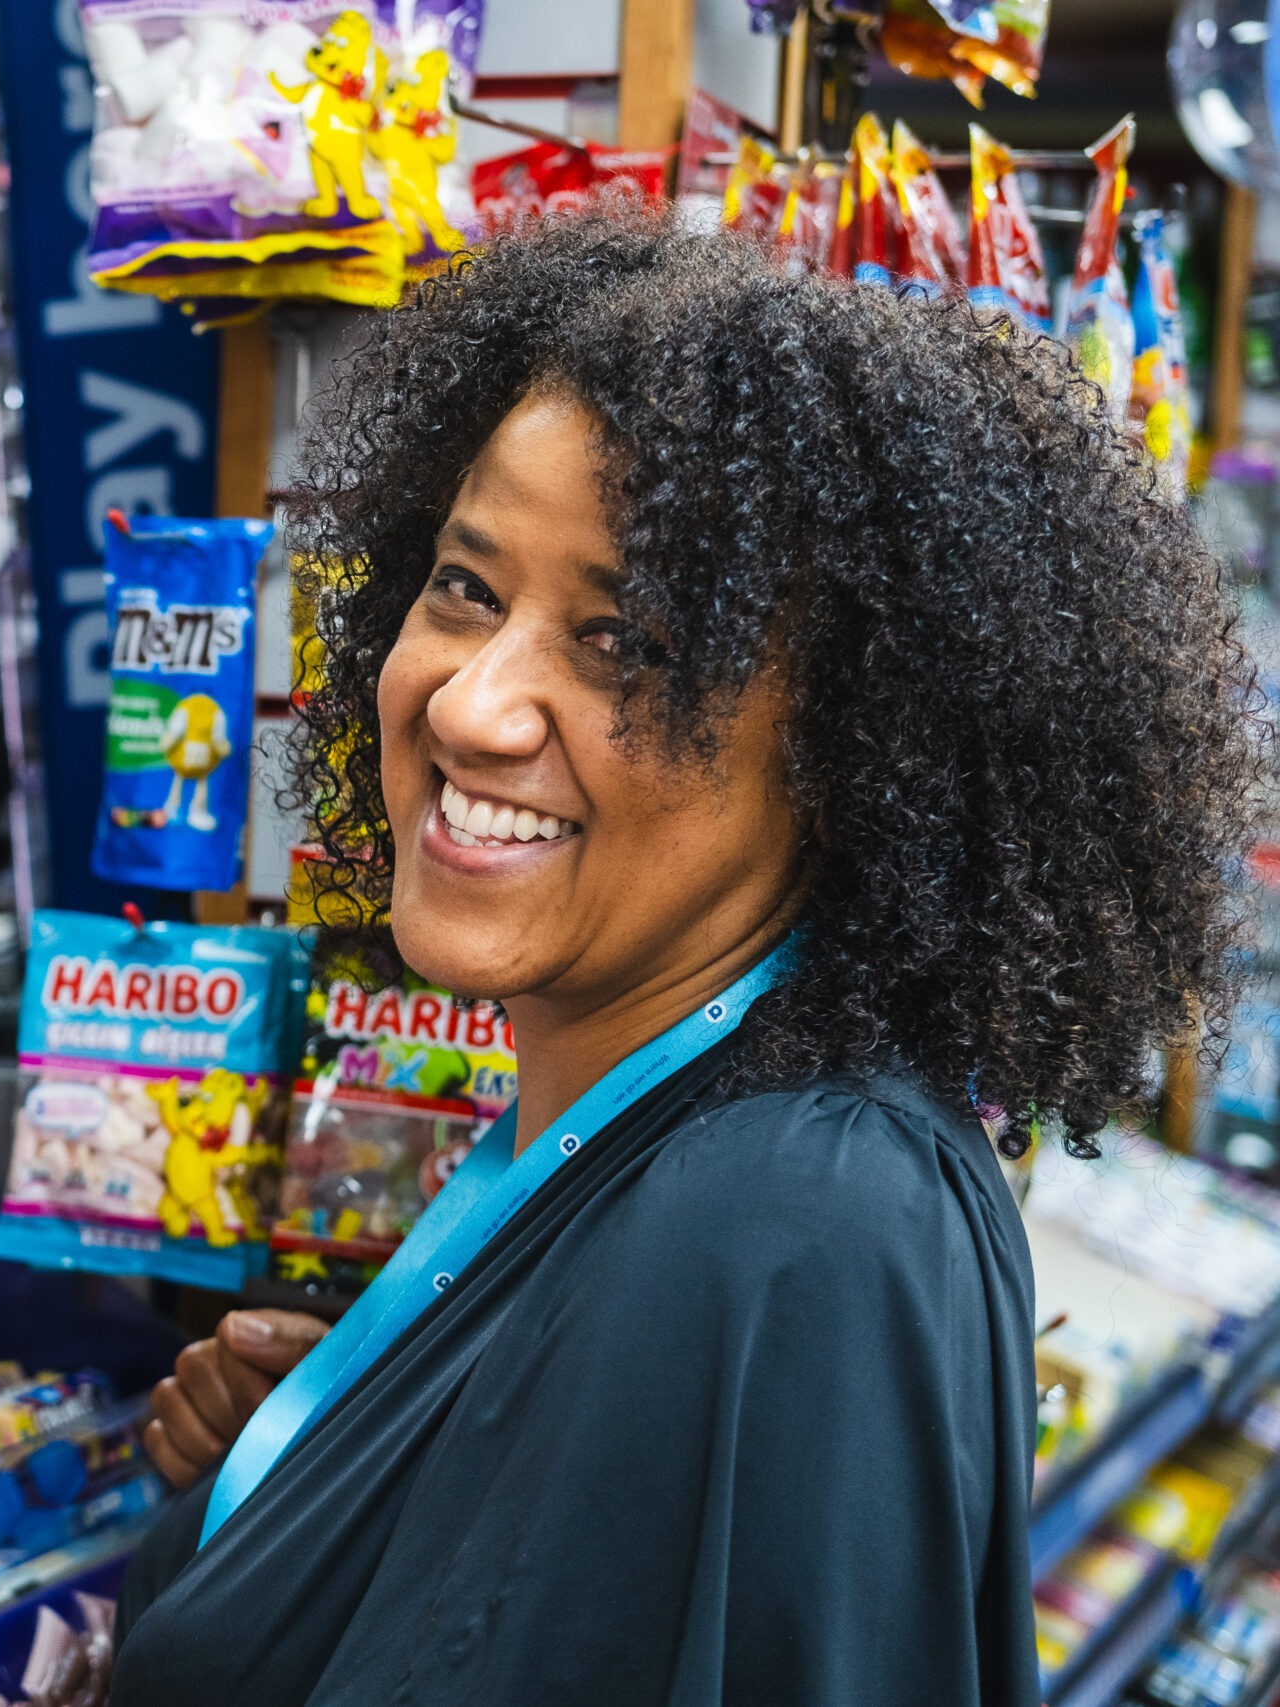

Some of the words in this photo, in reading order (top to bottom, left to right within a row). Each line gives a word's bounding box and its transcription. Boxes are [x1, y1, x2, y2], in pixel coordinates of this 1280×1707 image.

[48, 961, 240, 1019] HARIBO
[645, 1054, 670, 1075] Where
[634, 1074, 647, 1085] we
[613, 1092, 626, 1104] win
